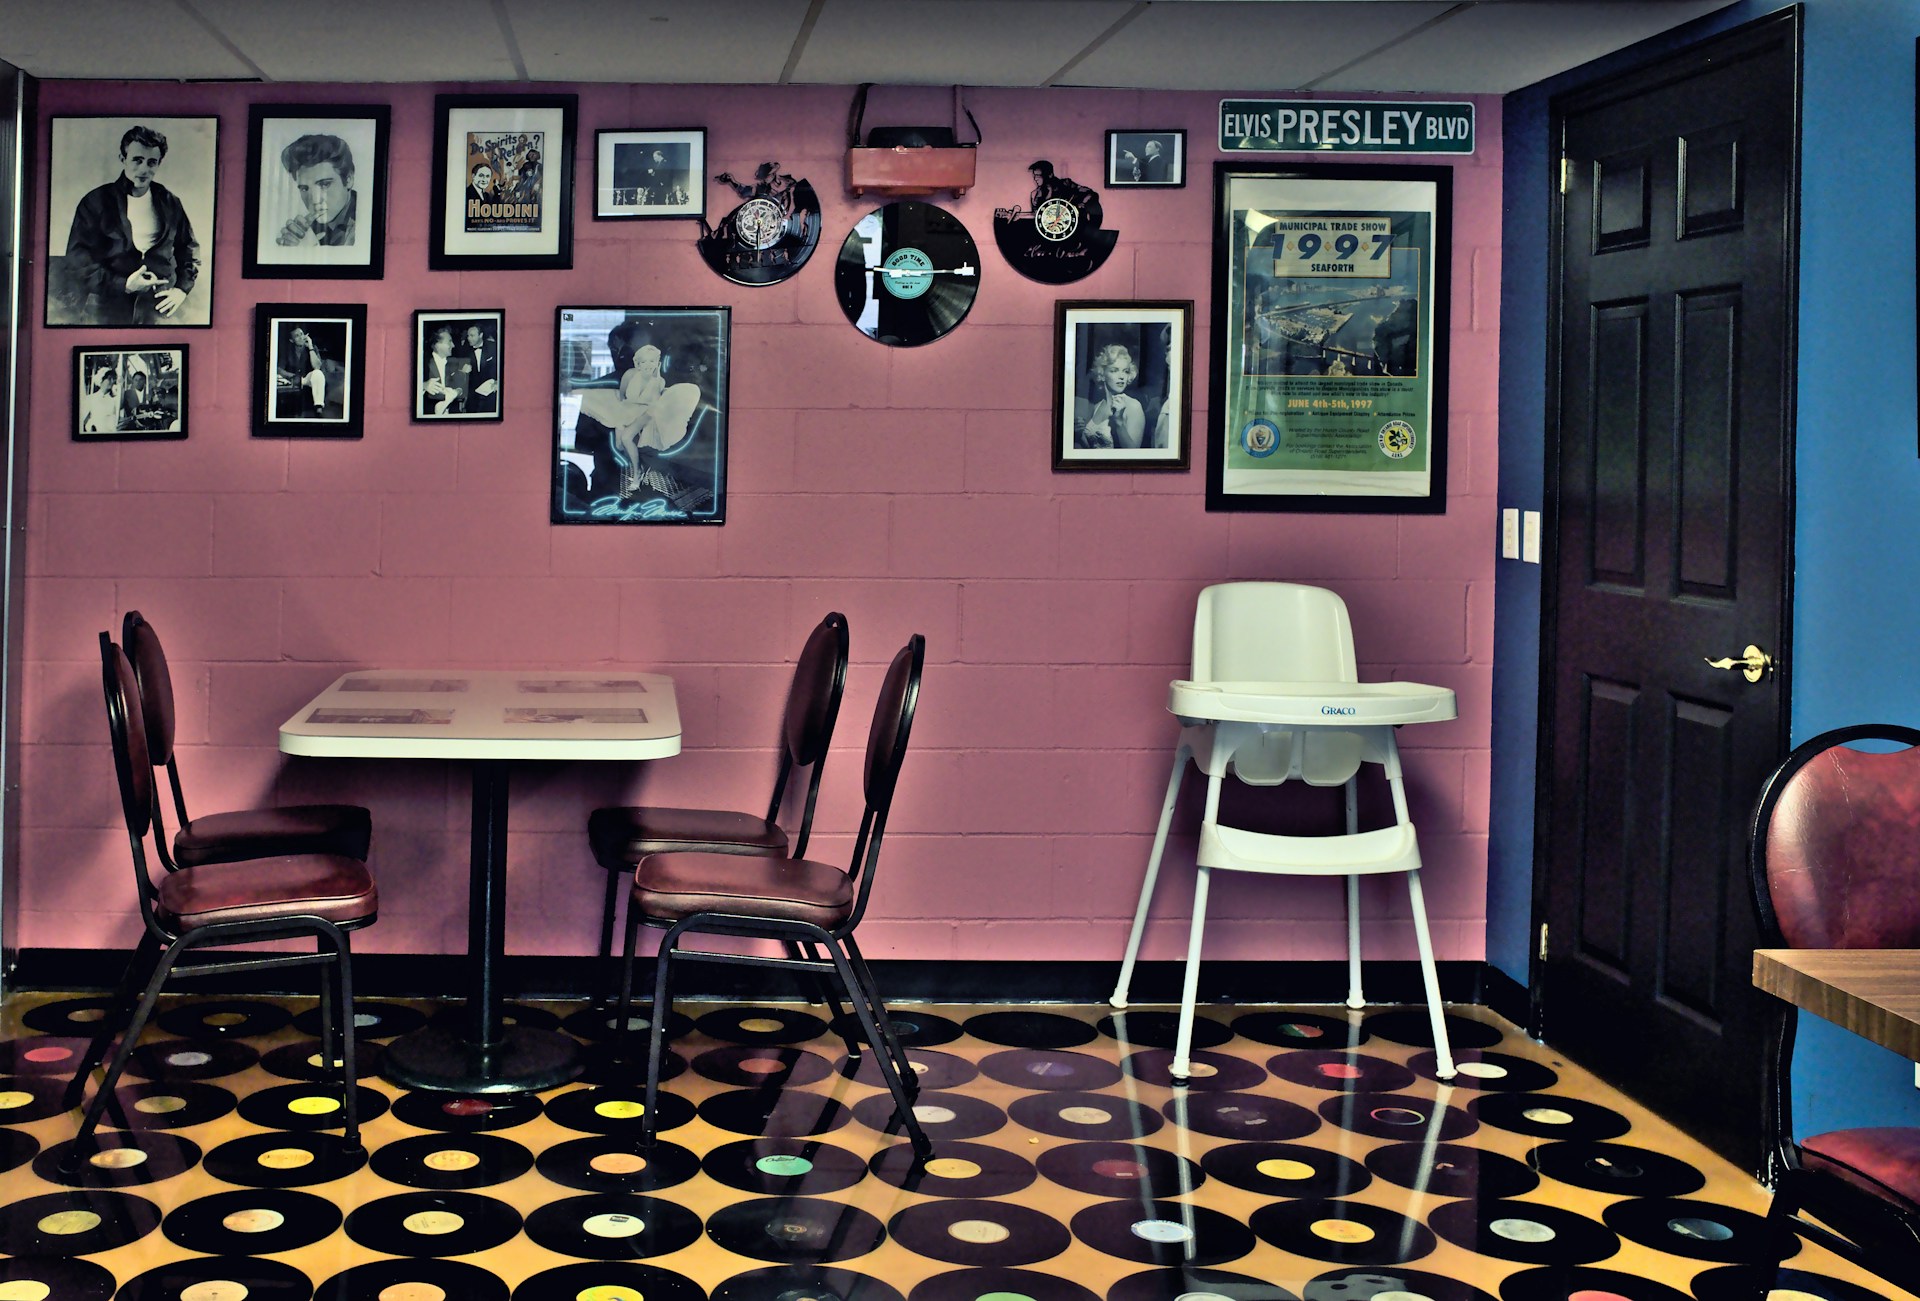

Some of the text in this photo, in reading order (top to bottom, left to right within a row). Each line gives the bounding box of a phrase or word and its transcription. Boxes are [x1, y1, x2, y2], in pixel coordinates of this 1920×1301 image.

[1224, 109, 1469, 145] ELVIS PRESLEY BLVD
[470, 134, 517, 156] Do Spirits
[468, 199, 539, 218] HOUDINI
[1279, 222, 1387, 231] MUNICIPAL TRADE SHOW
[910, 254, 926, 267] TIME
[1311, 263, 1354, 272] SEAFORTH
[1287, 399, 1309, 408] JUNE
[1351, 400, 1373, 409] 1997
